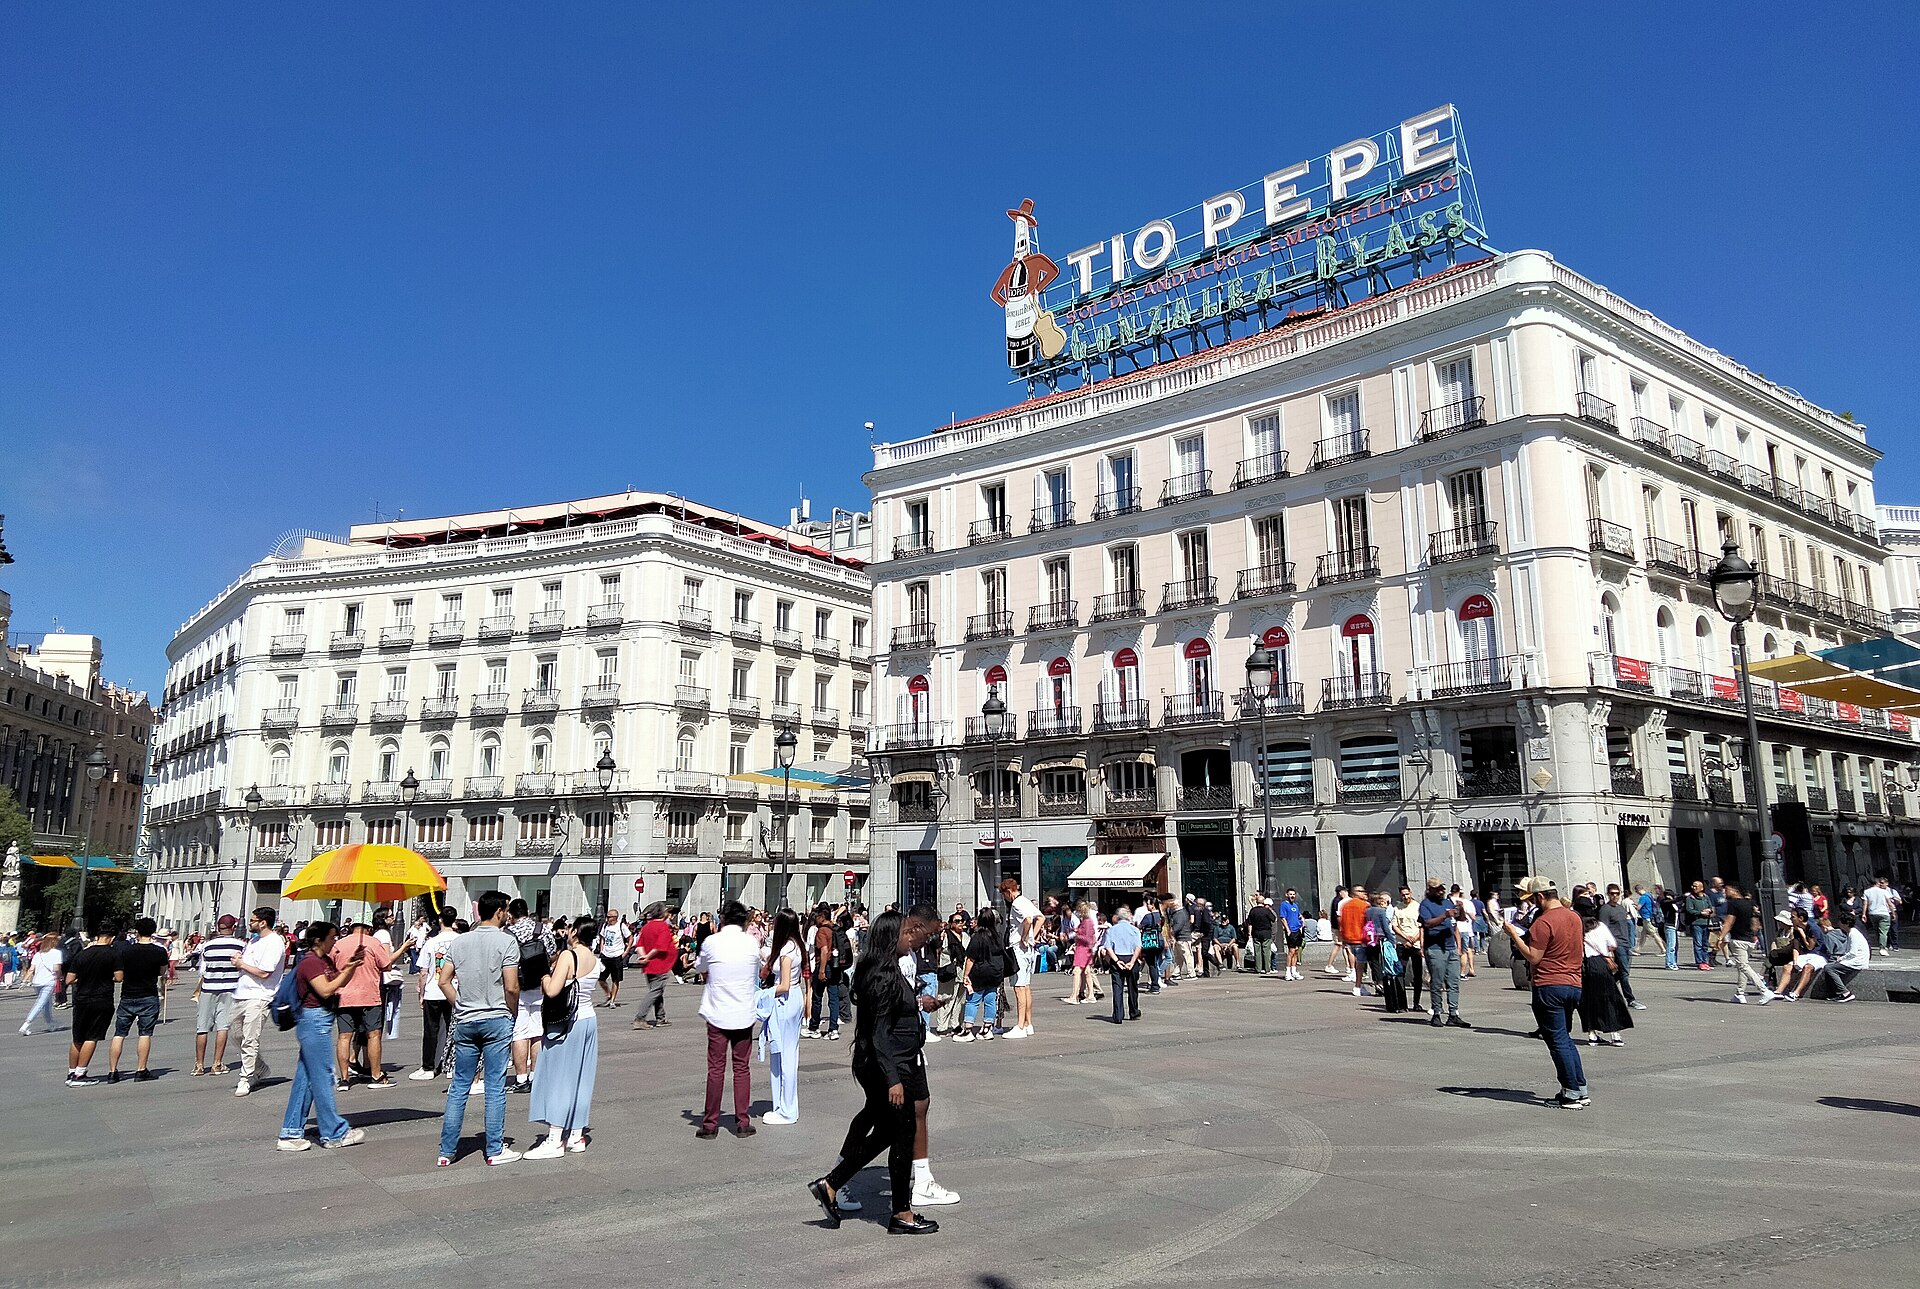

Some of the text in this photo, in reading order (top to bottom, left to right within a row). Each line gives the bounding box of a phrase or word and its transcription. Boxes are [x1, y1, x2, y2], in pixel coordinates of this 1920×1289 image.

[1067, 103, 1456, 294] TIO PEPE
[1066, 300, 1104, 325] SOL
[1110, 289, 1136, 309] DE
[1270, 175, 1456, 253] EMBOTELLADO
[1070, 202, 1466, 361] GONZALEZ BYASS
[1014, 317, 1031, 329] JEREZ
[1618, 812, 1650, 822] SEPHORA
[1460, 818, 1520, 829] SEPHORA
[978, 830, 1014, 839] PREOR
[1258, 825, 1309, 836] SPHORA
[1105, 879, 1135, 887] ITALIANOS
